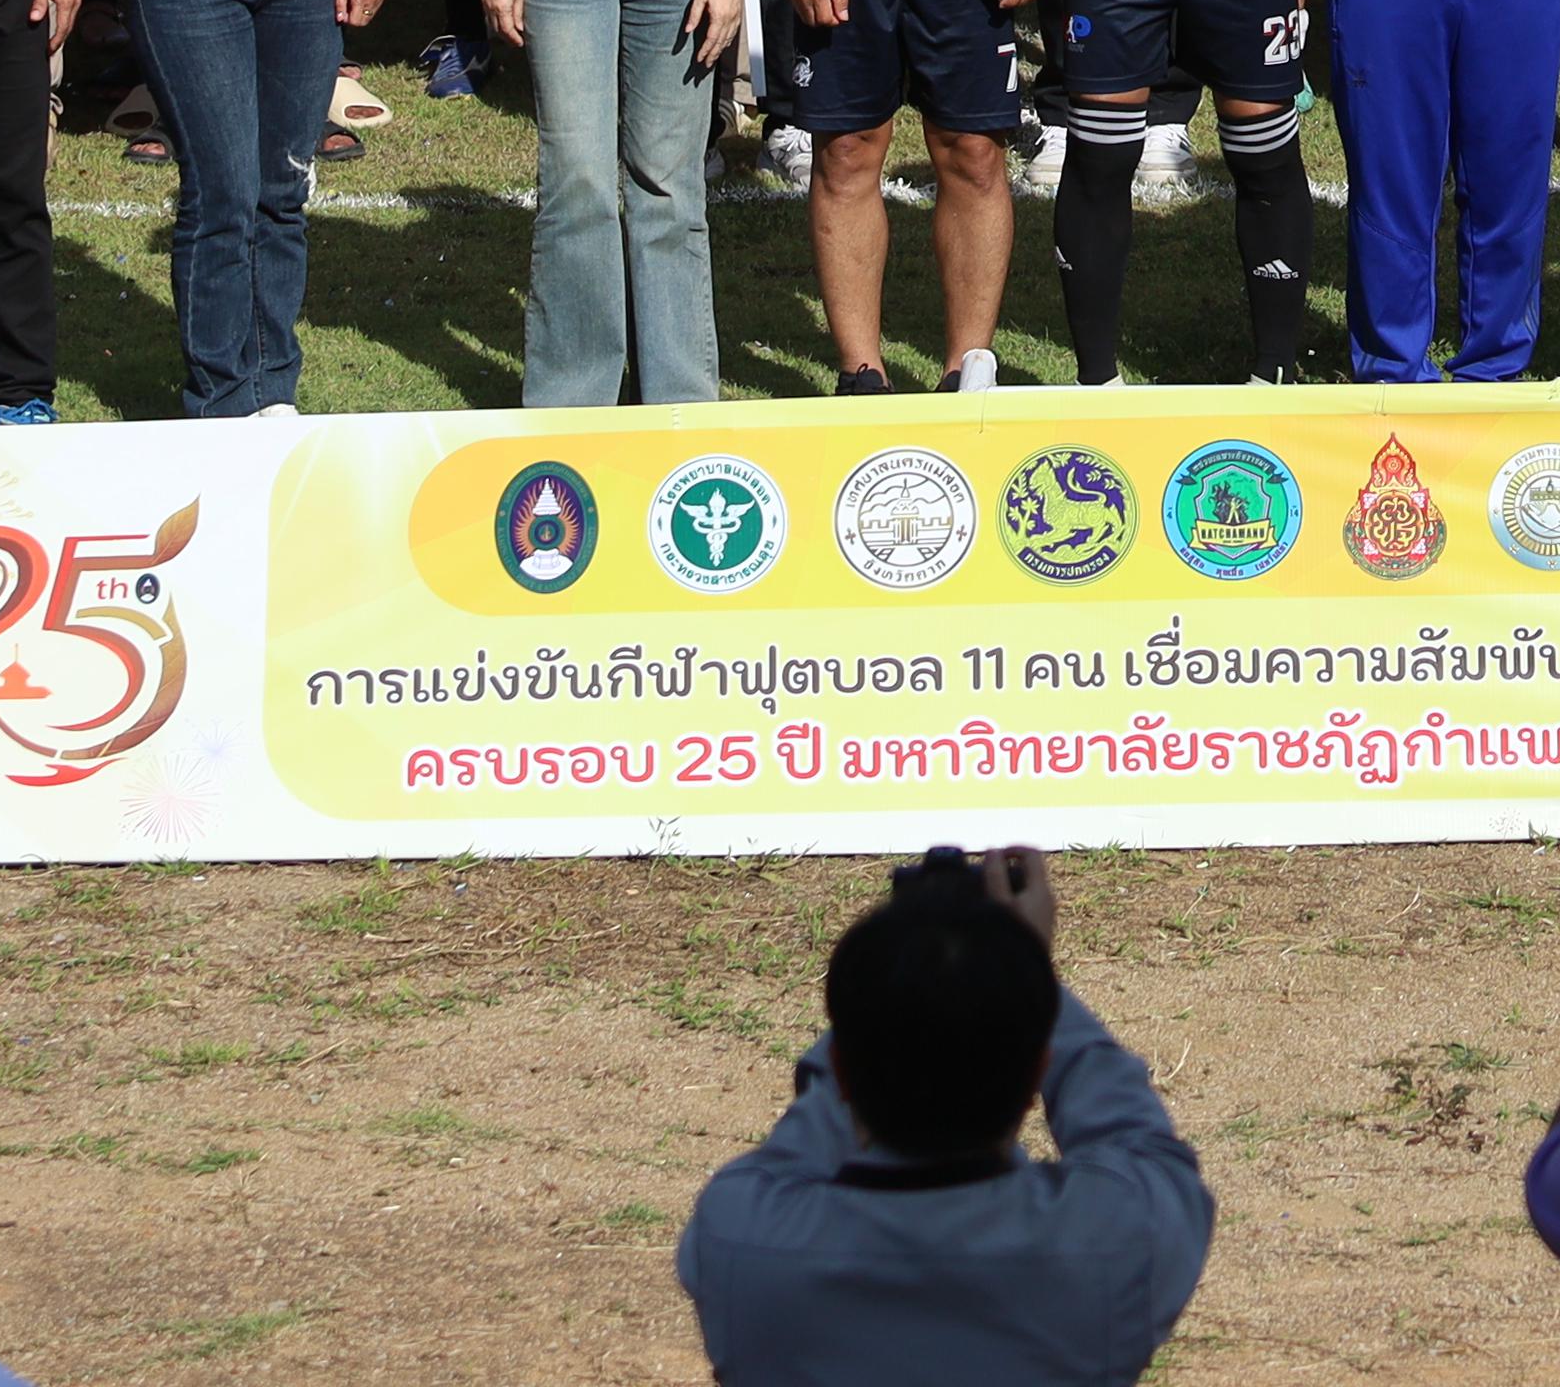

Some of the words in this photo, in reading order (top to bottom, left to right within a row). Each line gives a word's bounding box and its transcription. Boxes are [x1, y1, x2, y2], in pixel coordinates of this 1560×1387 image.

[845, 457, 966, 508] เทศบาลนครแม่สอด
[863, 558, 947, 583] จังหวัดตาก
[1023, 552, 1111, 578] กรมการปกครอง
[96, 577, 129, 601] th
[305, 644, 943, 716] การแข่งขันกีฬาฟุตบอล
[961, 646, 1004, 691] 11
[1024, 651, 1106, 690] คน
[406, 745, 655, 788] ครบรอบ
[676, 735, 757, 783] 25
[777, 722, 822, 780] ปี
